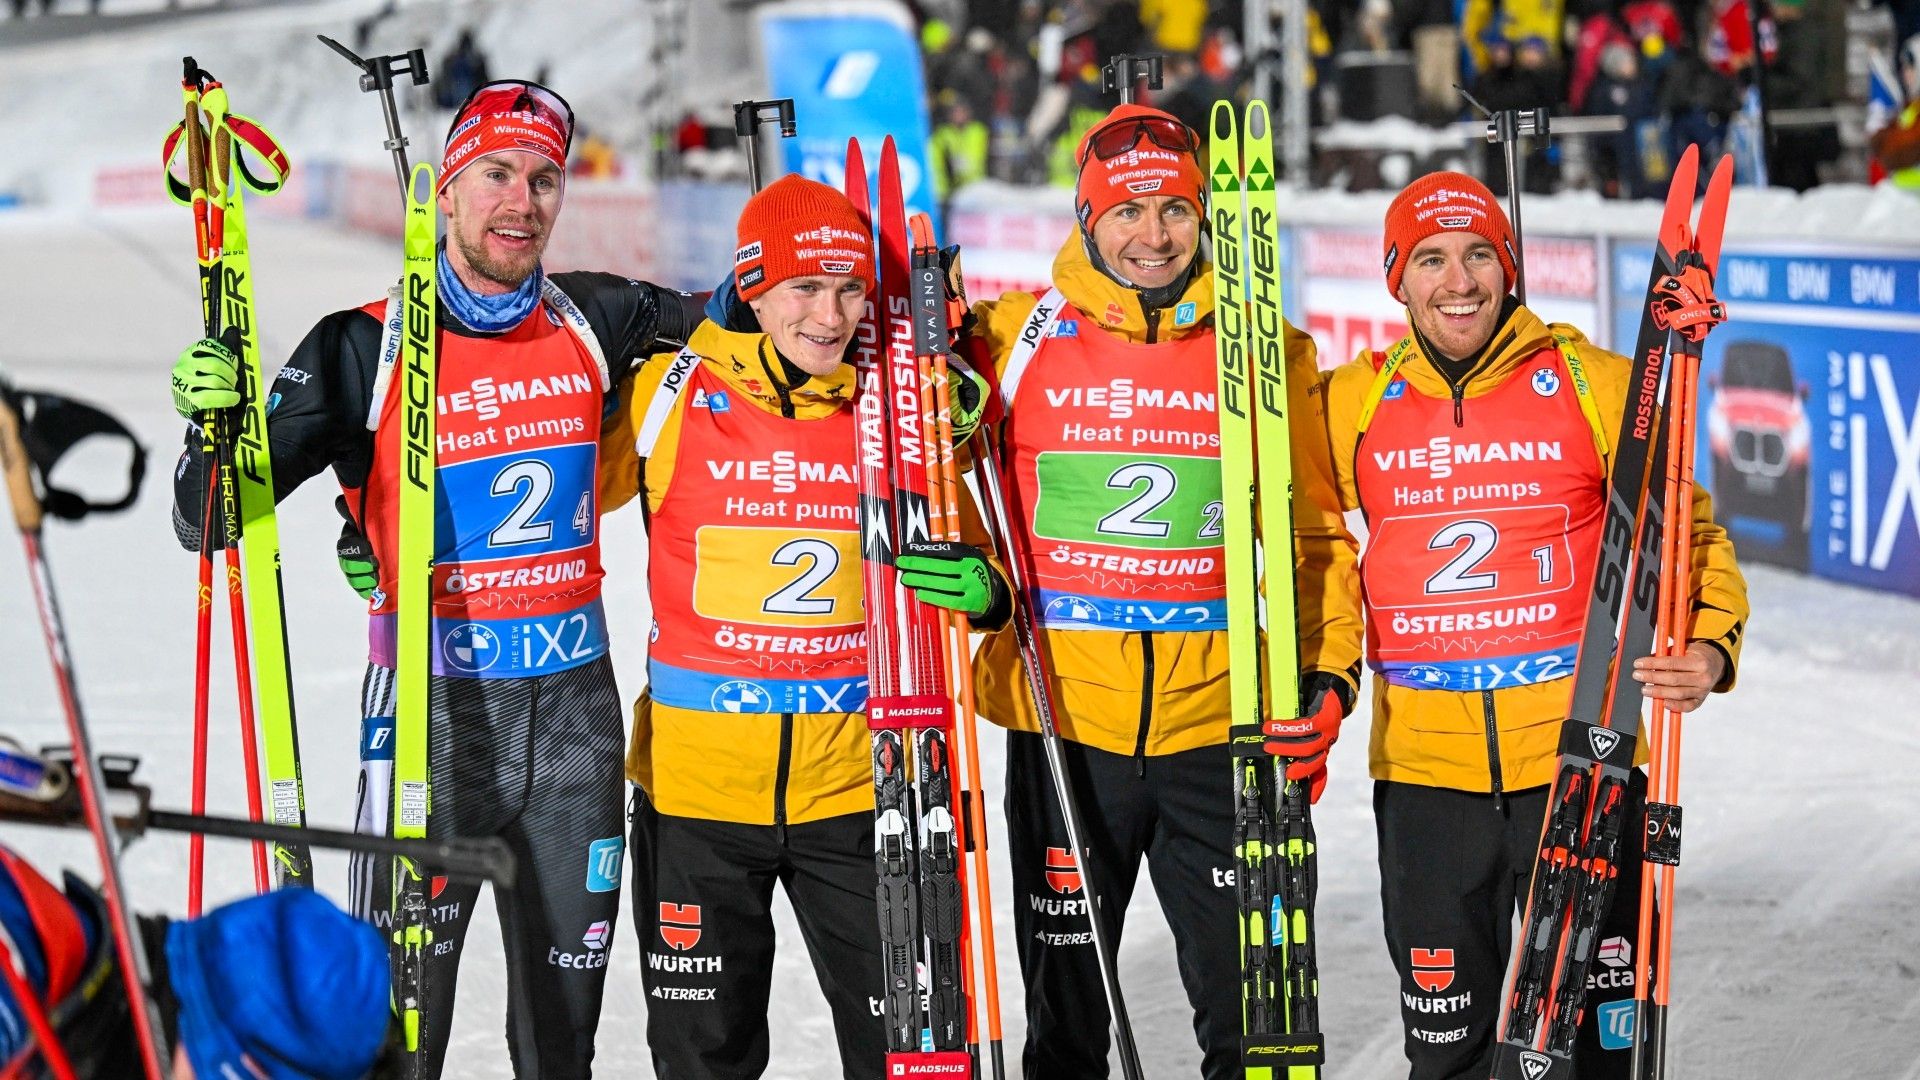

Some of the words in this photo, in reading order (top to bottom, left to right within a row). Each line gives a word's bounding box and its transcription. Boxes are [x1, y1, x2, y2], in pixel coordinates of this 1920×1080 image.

[446, 134, 482, 169] TERREX
[1106, 149, 1179, 170] VIESSMANN
[1108, 168, 1179, 187] Wärmepumpen
[1414, 189, 1487, 208] VIESSMANN
[1416, 205, 1487, 222] Wärmepumpen
[794, 226, 866, 244] VIESSMANN
[740, 244, 761, 260] testo
[796, 248, 866, 260] Wärmepumpen
[743, 269, 763, 284] TERREX
[1021, 307, 1052, 348] JOKA
[1216, 208, 1246, 419] FISCHER
[1251, 206, 1283, 418] FISCHER
[407, 272, 430, 492] FISCHER
[663, 353, 696, 394] JOKA
[856, 300, 885, 469] MADSHUS
[888, 295, 922, 465] MADSHUS
[437, 372, 592, 421] IESSMANN
[1044, 378, 1215, 419] VIESSMAN
[1632, 345, 1663, 441] ROSSIGNOL
[436, 426, 498, 455] Heat
[504, 416, 585, 446] pumps
[1062, 424, 1123, 442] Heat
[1132, 426, 1221, 450] pumps
[706, 450, 858, 493] VIESSMA
[1373, 436, 1562, 479] VIESSMANN
[487, 458, 554, 548] 2
[1095, 461, 1178, 538] 2
[1394, 485, 1445, 506] Heat
[1453, 481, 1542, 506] pumps
[572, 491, 590, 536] 4
[725, 497, 787, 517] Heat
[796, 503, 860, 524] pum
[1197, 500, 1223, 539] 2
[337, 545, 361, 556] oeckl
[1049, 545, 1215, 576] ÖSTERSUND
[1423, 518, 1500, 596] 2
[1531, 544, 1553, 585] 1
[446, 559, 587, 593] ÖSTERSUND
[762, 538, 840, 616] 2
[1054, 598, 1094, 613] BMW
[1392, 603, 1557, 635] ÖSTERSUND
[453, 626, 493, 641] BMW
[523, 613, 593, 668] iX2
[721, 681, 764, 697] BMW
[887, 707, 943, 717] MADSHUS
[1271, 722, 1313, 733] Roeckl
[1030, 894, 1101, 916] WÜRT
[646, 951, 722, 973] WÜRTH
[662, 987, 716, 1000] TERREX
[1402, 991, 1471, 1014] WÜRTH
[1247, 1045, 1319, 1054] FISCHER
[1420, 1026, 1469, 1044] TERREX
[909, 1064, 965, 1073] MADSHUS
